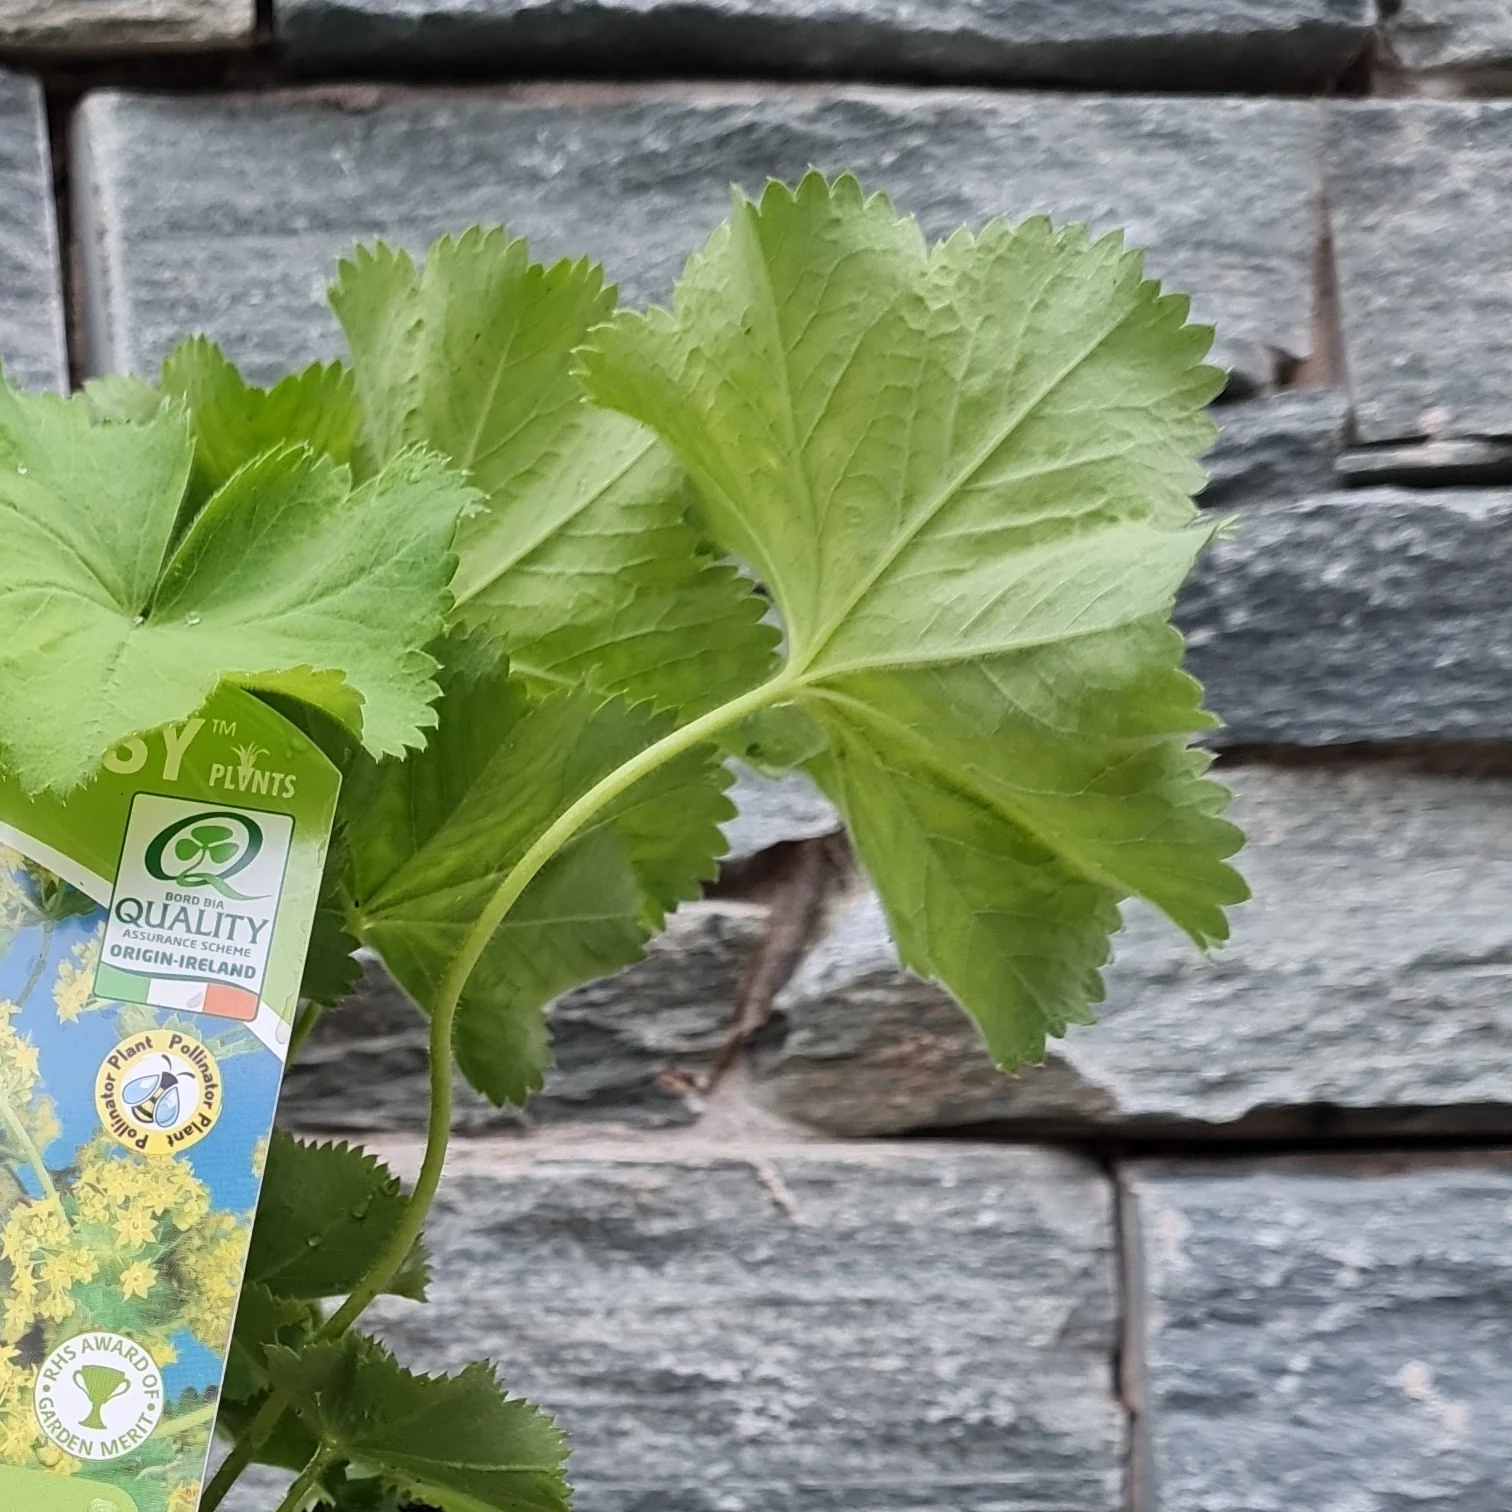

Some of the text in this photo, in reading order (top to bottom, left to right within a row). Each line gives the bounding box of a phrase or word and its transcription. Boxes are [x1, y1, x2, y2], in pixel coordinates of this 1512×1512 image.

[115, 897, 270, 945] QUALITY
[165, 891, 225, 910] BORD BIA
[110, 944, 256, 980] ORIGIN-IRELAND
[122, 928, 252, 958] ASSURANCE SCHEME
[100, 1036, 153, 1149] Pollinator Plant
[166, 1034, 218, 1147] Pollinator Plant
[43, 1336, 160, 1399] RHS AWARD OF
[39, 1397, 154, 1456] GARDEN MERIT
